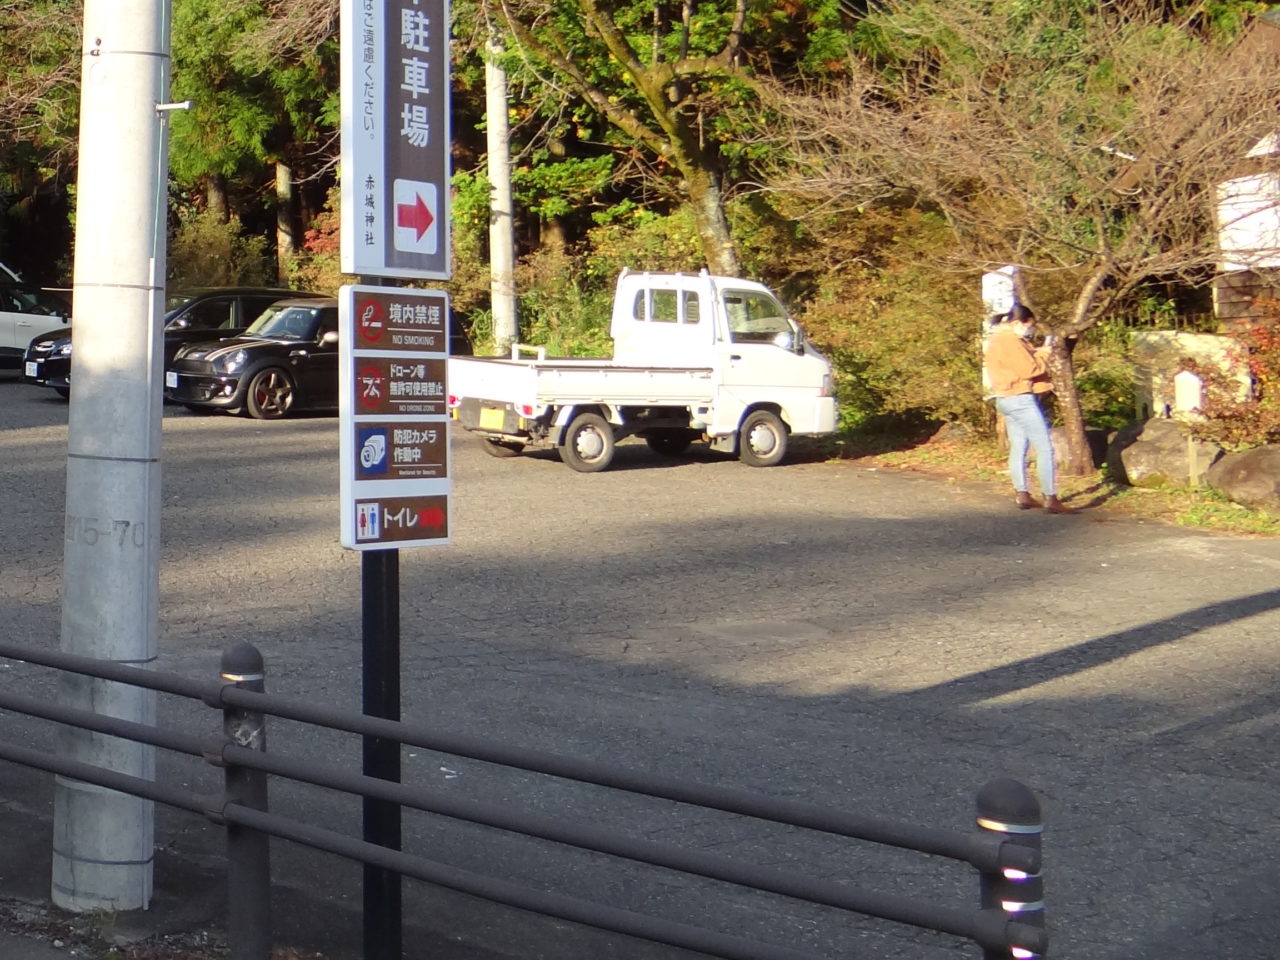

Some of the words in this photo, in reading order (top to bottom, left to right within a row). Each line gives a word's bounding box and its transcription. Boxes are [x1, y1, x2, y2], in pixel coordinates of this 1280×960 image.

[364, 173, 375, 246] 赤城神社
[389, 303, 440, 325] 境内禁煙
[393, 335, 402, 345] NO
[404, 335, 435, 345] SMOKING
[390, 363, 425, 379] ドローン等
[389, 381, 443, 396] 無許可使用禁止
[393, 429, 437, 444] 防犯カメラ
[393, 447, 421, 463] 作動中
[383, 507, 417, 529] トイレ
